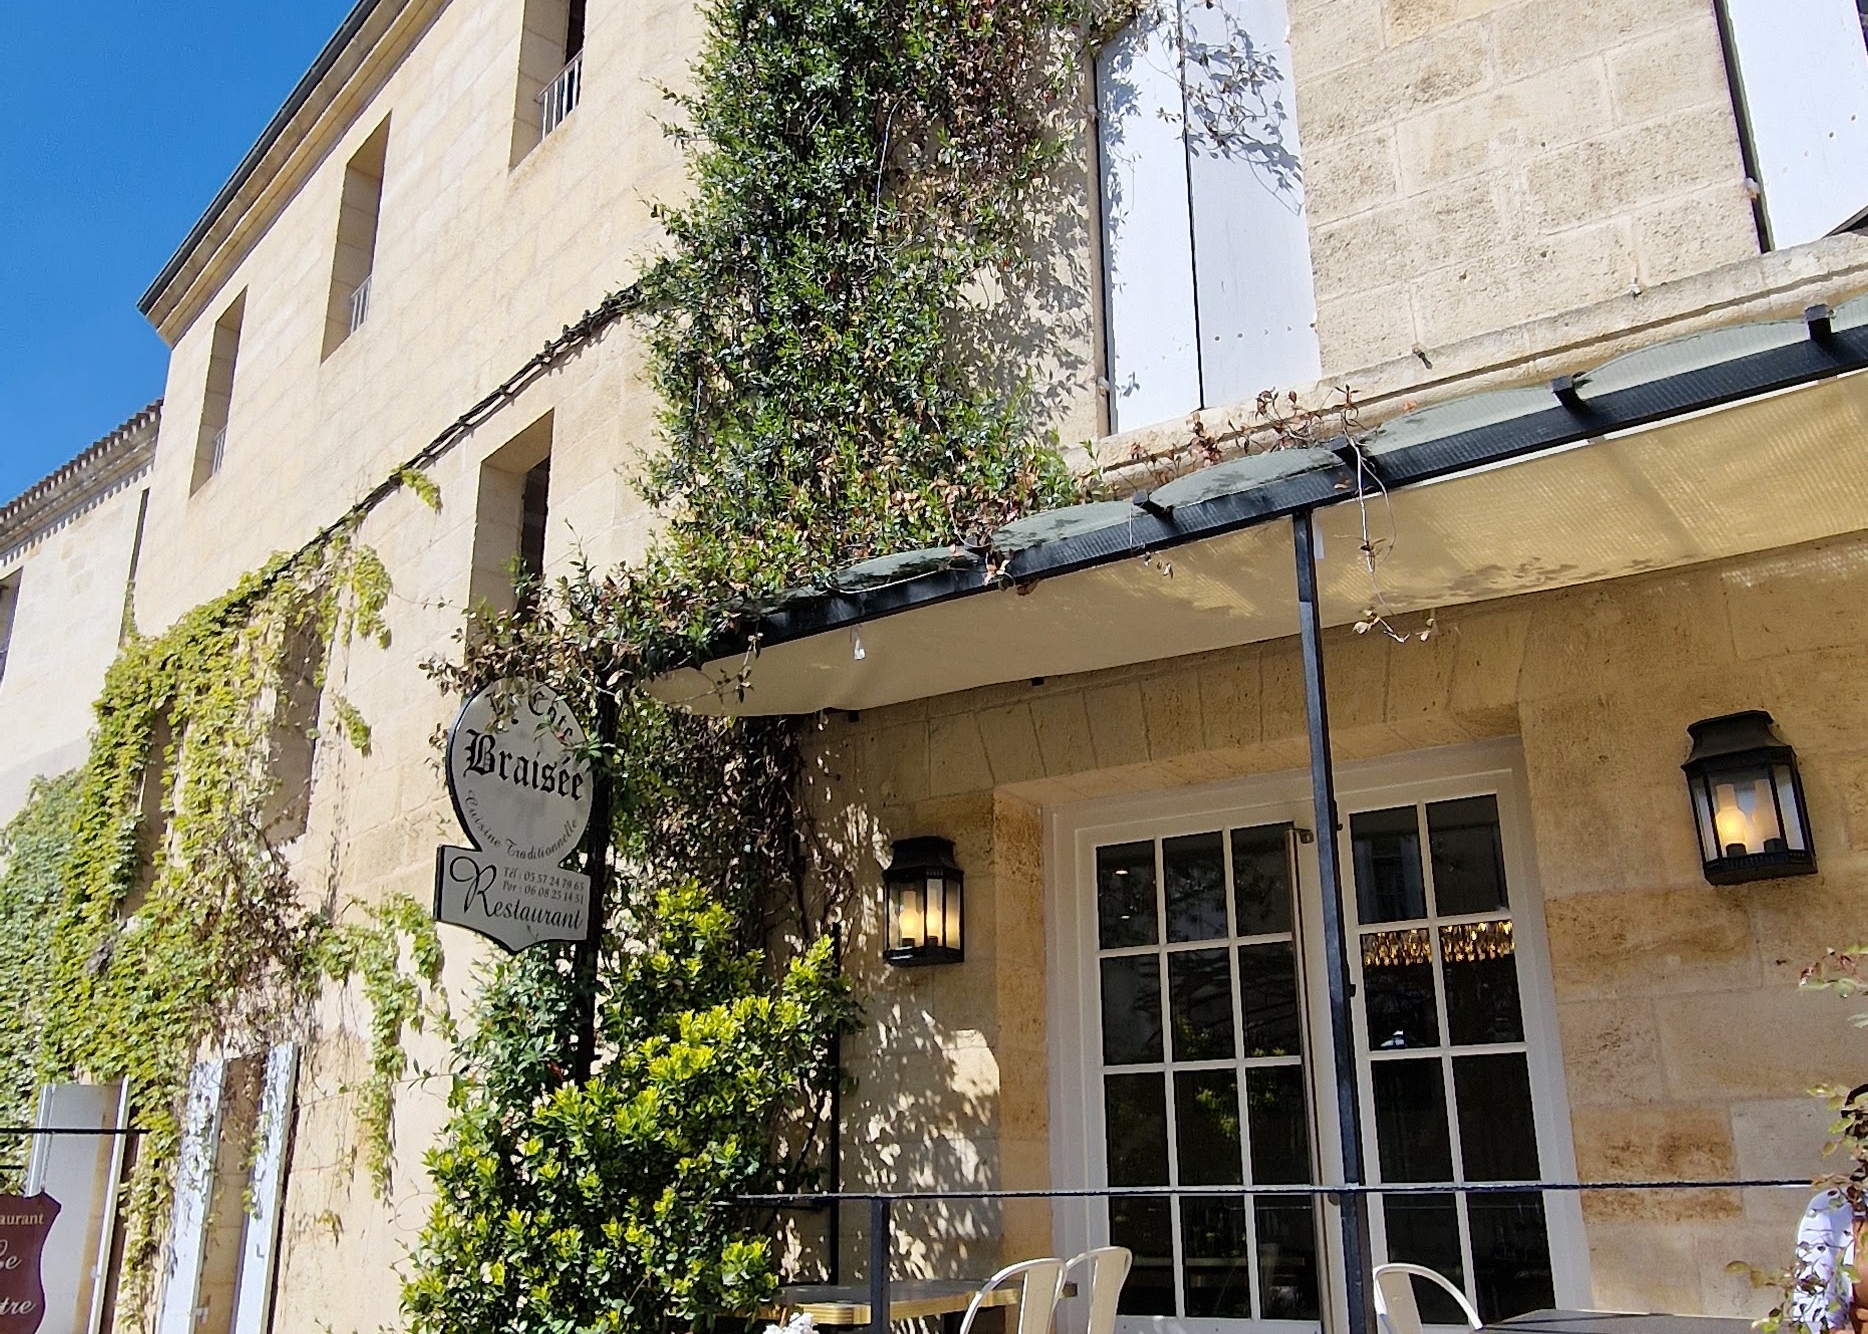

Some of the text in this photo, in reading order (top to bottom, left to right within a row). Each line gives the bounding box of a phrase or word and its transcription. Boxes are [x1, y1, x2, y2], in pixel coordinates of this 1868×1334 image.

[463, 728, 584, 801] Braisée
[465, 790, 577, 860] Cuisine Traditionnelle
[449, 856, 583, 929] Restaurant
[524, 871, 535, 882] 05
[537, 874, 548, 884] 57
[549, 876, 560, 887] 24
[562, 878, 572, 889] 79
[524, 885, 536, 896] 06
[538, 887, 550, 898] 08
[551, 889, 562, 900] 25
[564, 892, 573, 902] 14
